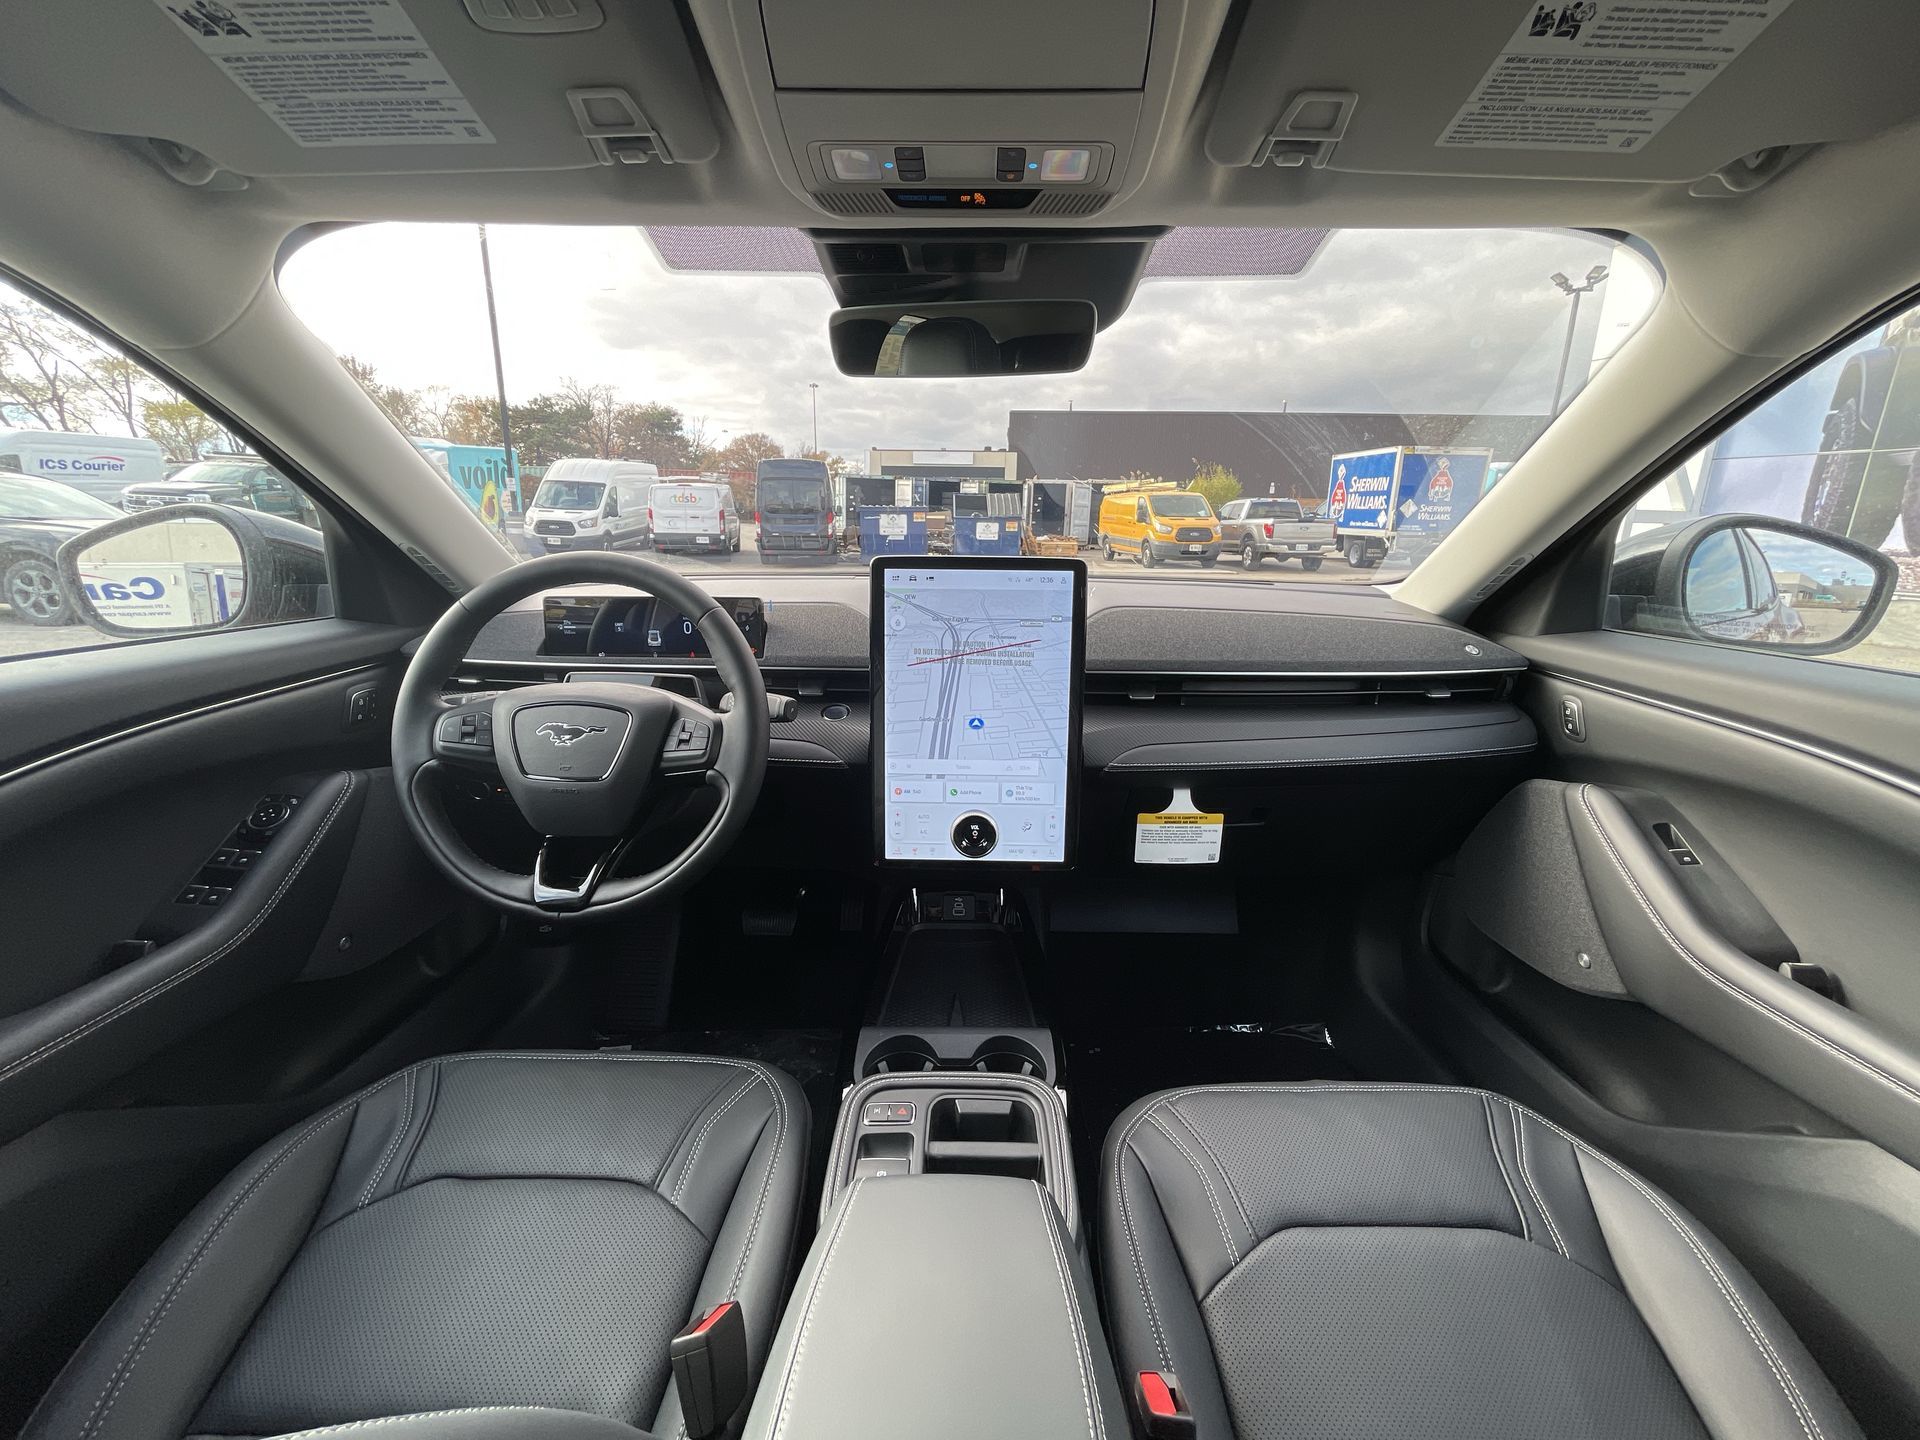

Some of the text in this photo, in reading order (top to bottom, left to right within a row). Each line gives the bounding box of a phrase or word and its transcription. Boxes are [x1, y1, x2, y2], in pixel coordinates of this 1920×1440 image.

[39, 459, 126, 471] ICS Courier
[1350, 476, 1389, 492] SHERWIN
[673, 493, 697, 503] tdsb
[1346, 493, 1388, 510] WILLIAMS.
[1419, 504, 1453, 513] SHERWIN
[1417, 512, 1451, 521] WILLIAMS.
[683, 621, 692, 634] 0
[913, 647, 922, 655] DO
